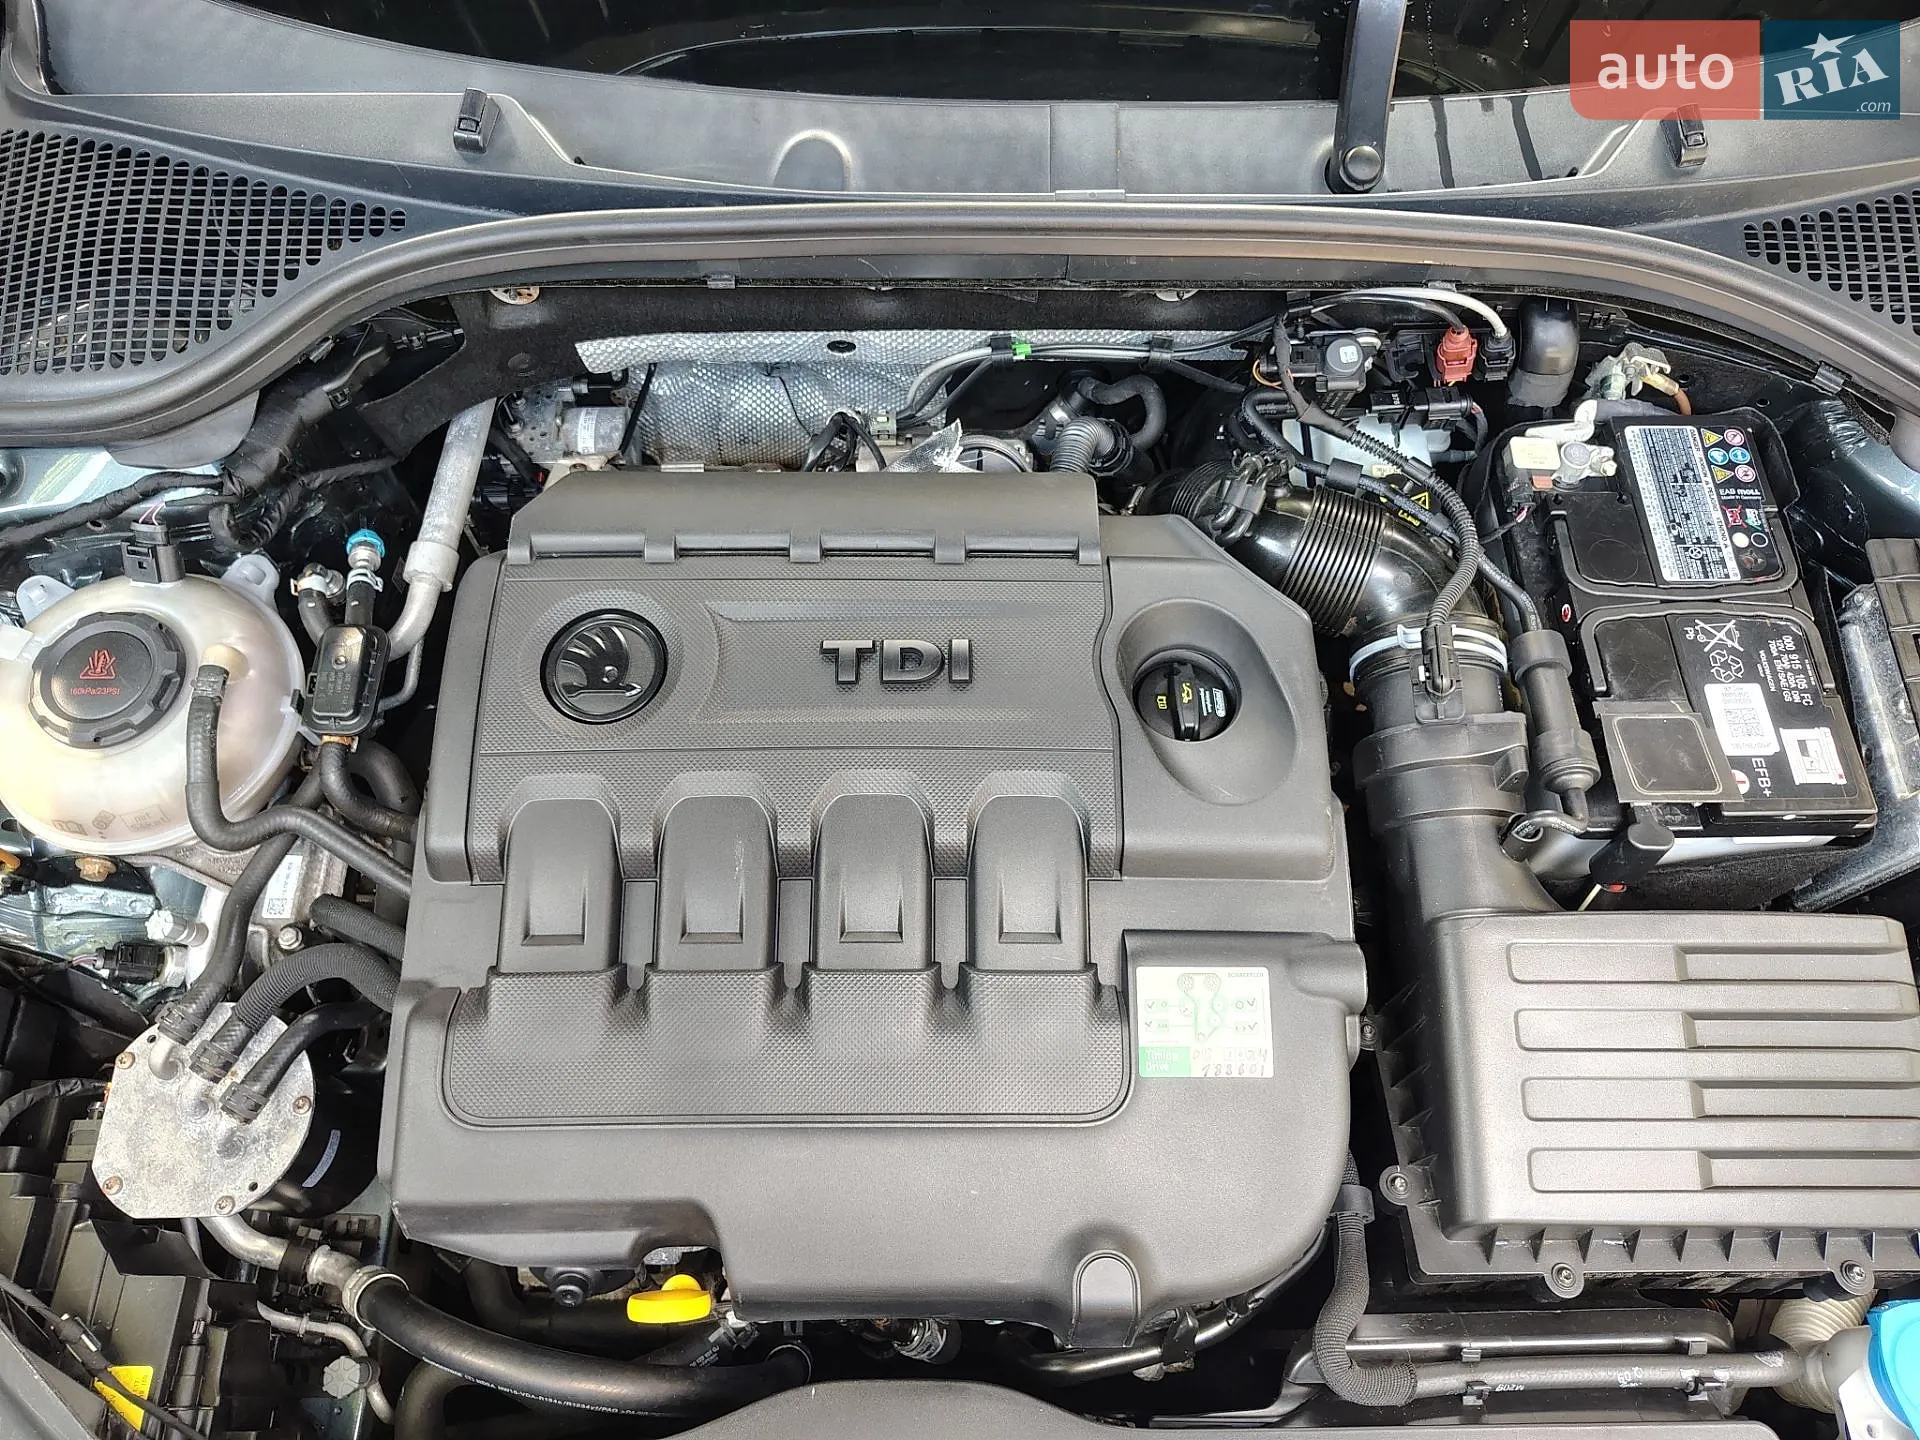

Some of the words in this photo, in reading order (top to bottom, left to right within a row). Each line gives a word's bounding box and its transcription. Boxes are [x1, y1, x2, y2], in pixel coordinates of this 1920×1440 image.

[1683, 626, 1697, 641] Pb
[819, 638, 973, 685] TDI
[1789, 653, 1803, 670] 915
[1795, 673, 1809, 690] 105
[1800, 693, 1814, 706] FC
[1751, 757, 1774, 798] EFB+
